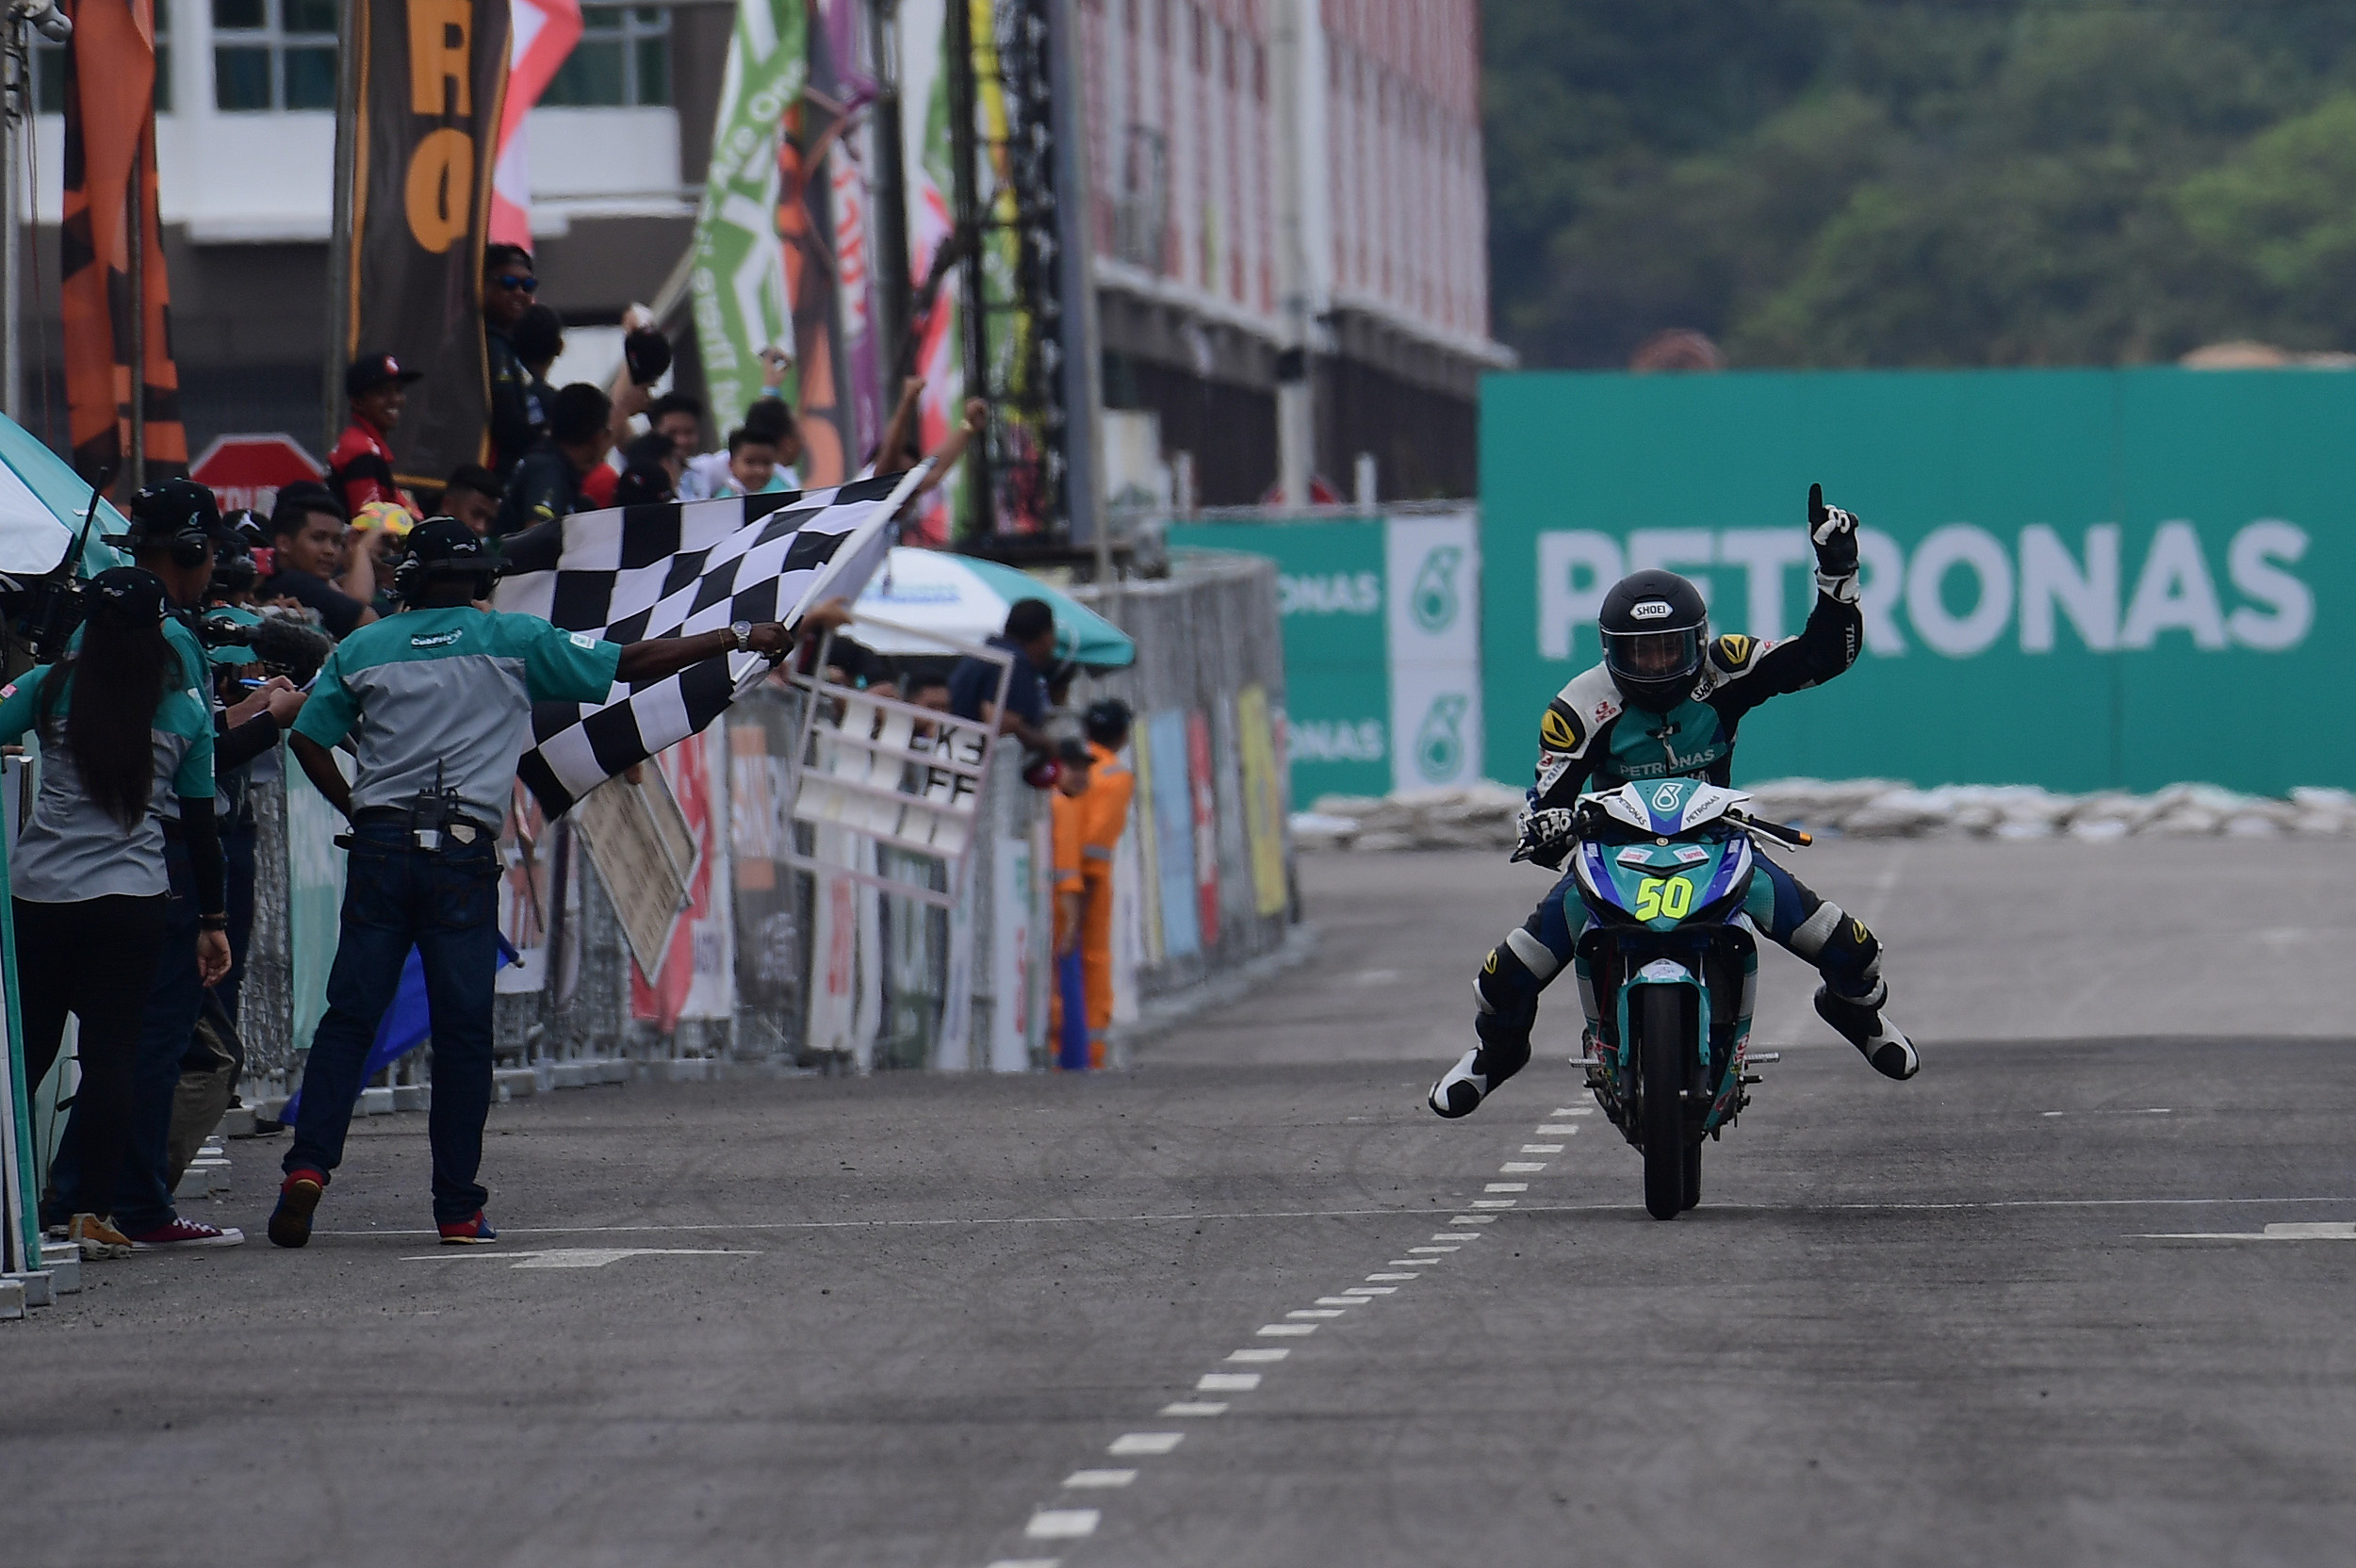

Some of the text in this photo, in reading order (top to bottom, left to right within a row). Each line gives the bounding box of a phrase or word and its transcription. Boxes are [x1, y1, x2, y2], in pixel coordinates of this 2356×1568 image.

[1636, 605, 1666, 616] SHOEI
[1686, 795, 1721, 824] PETRONAS
[1635, 876, 1693, 922] 50
